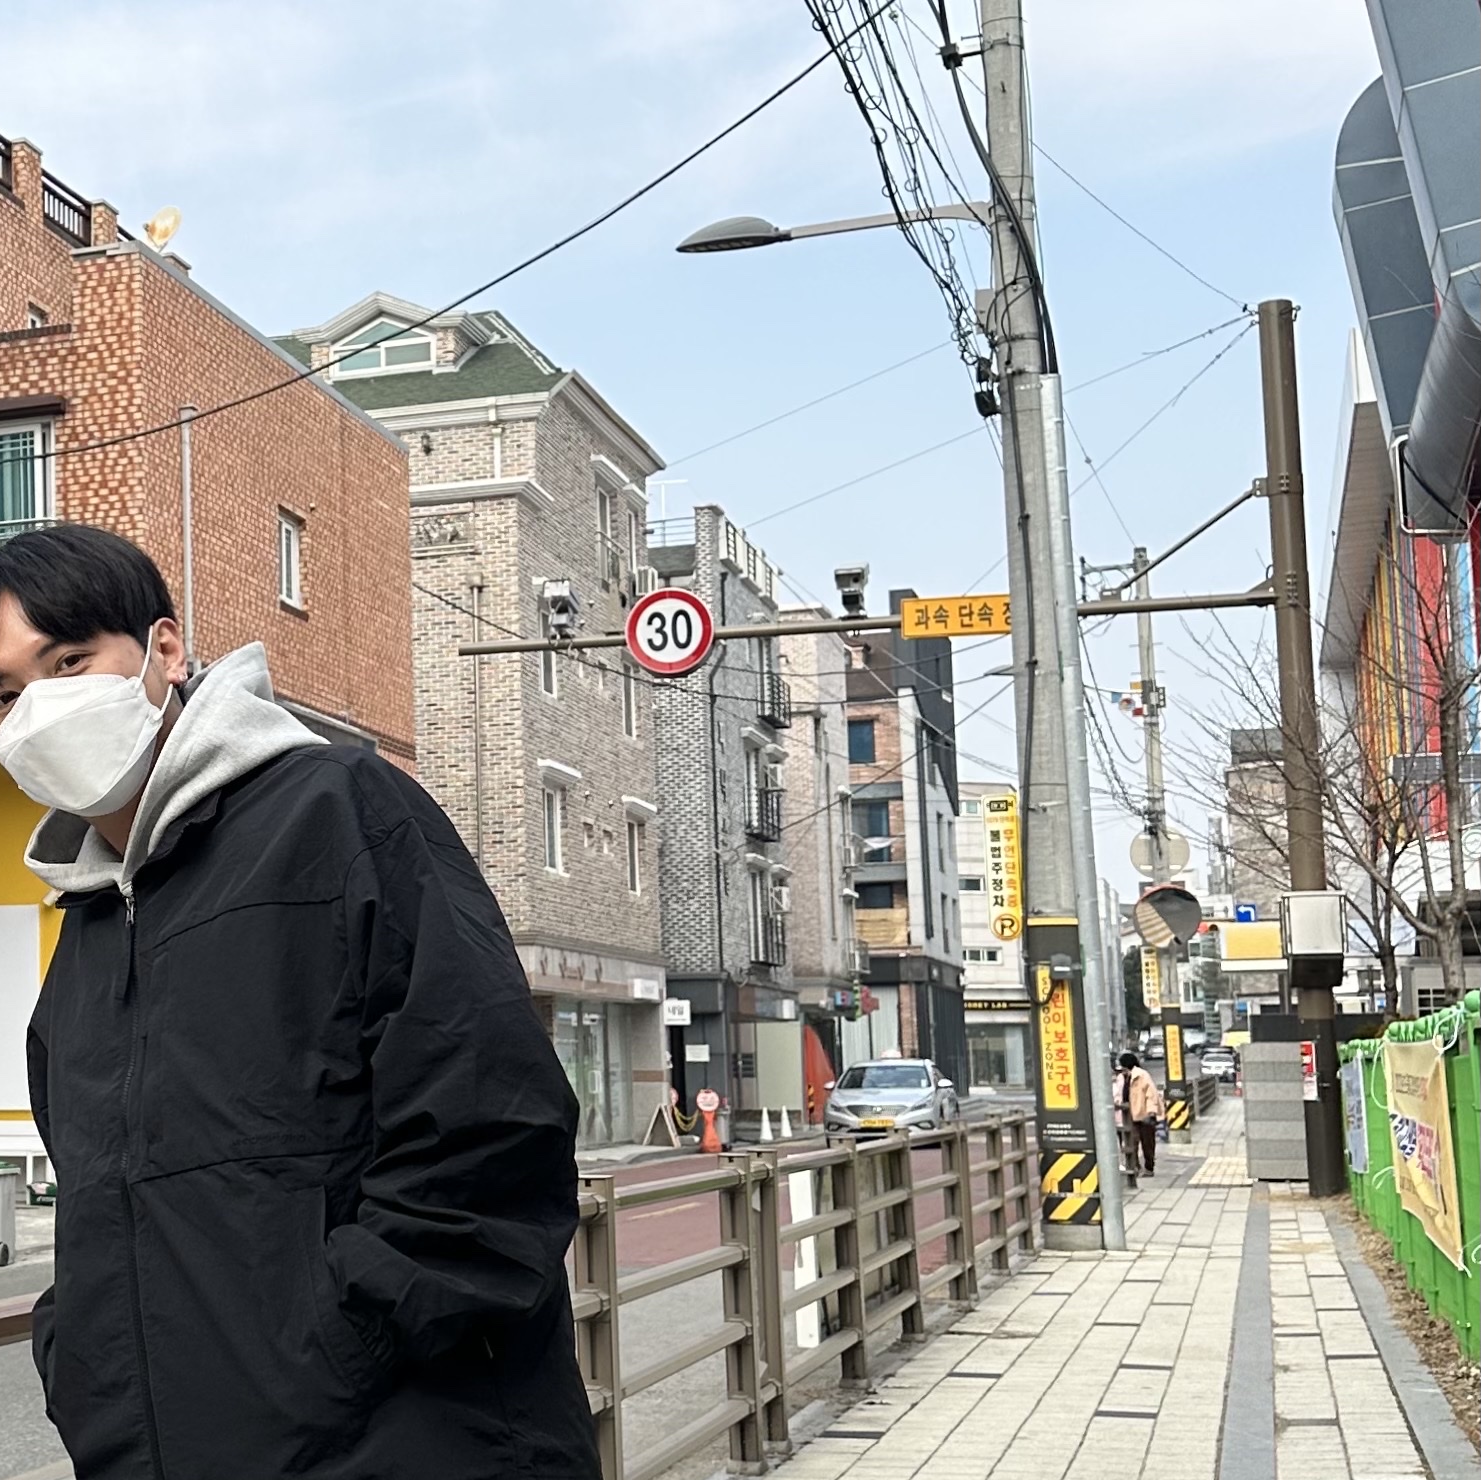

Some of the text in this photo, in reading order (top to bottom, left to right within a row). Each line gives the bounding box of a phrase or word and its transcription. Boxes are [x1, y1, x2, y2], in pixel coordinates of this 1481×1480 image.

[646, 610, 693, 652] 30
[914, 603, 950, 630] 과속
[958, 602, 994, 628] 단속
[1045, 1042, 1054, 1081] ZONE
